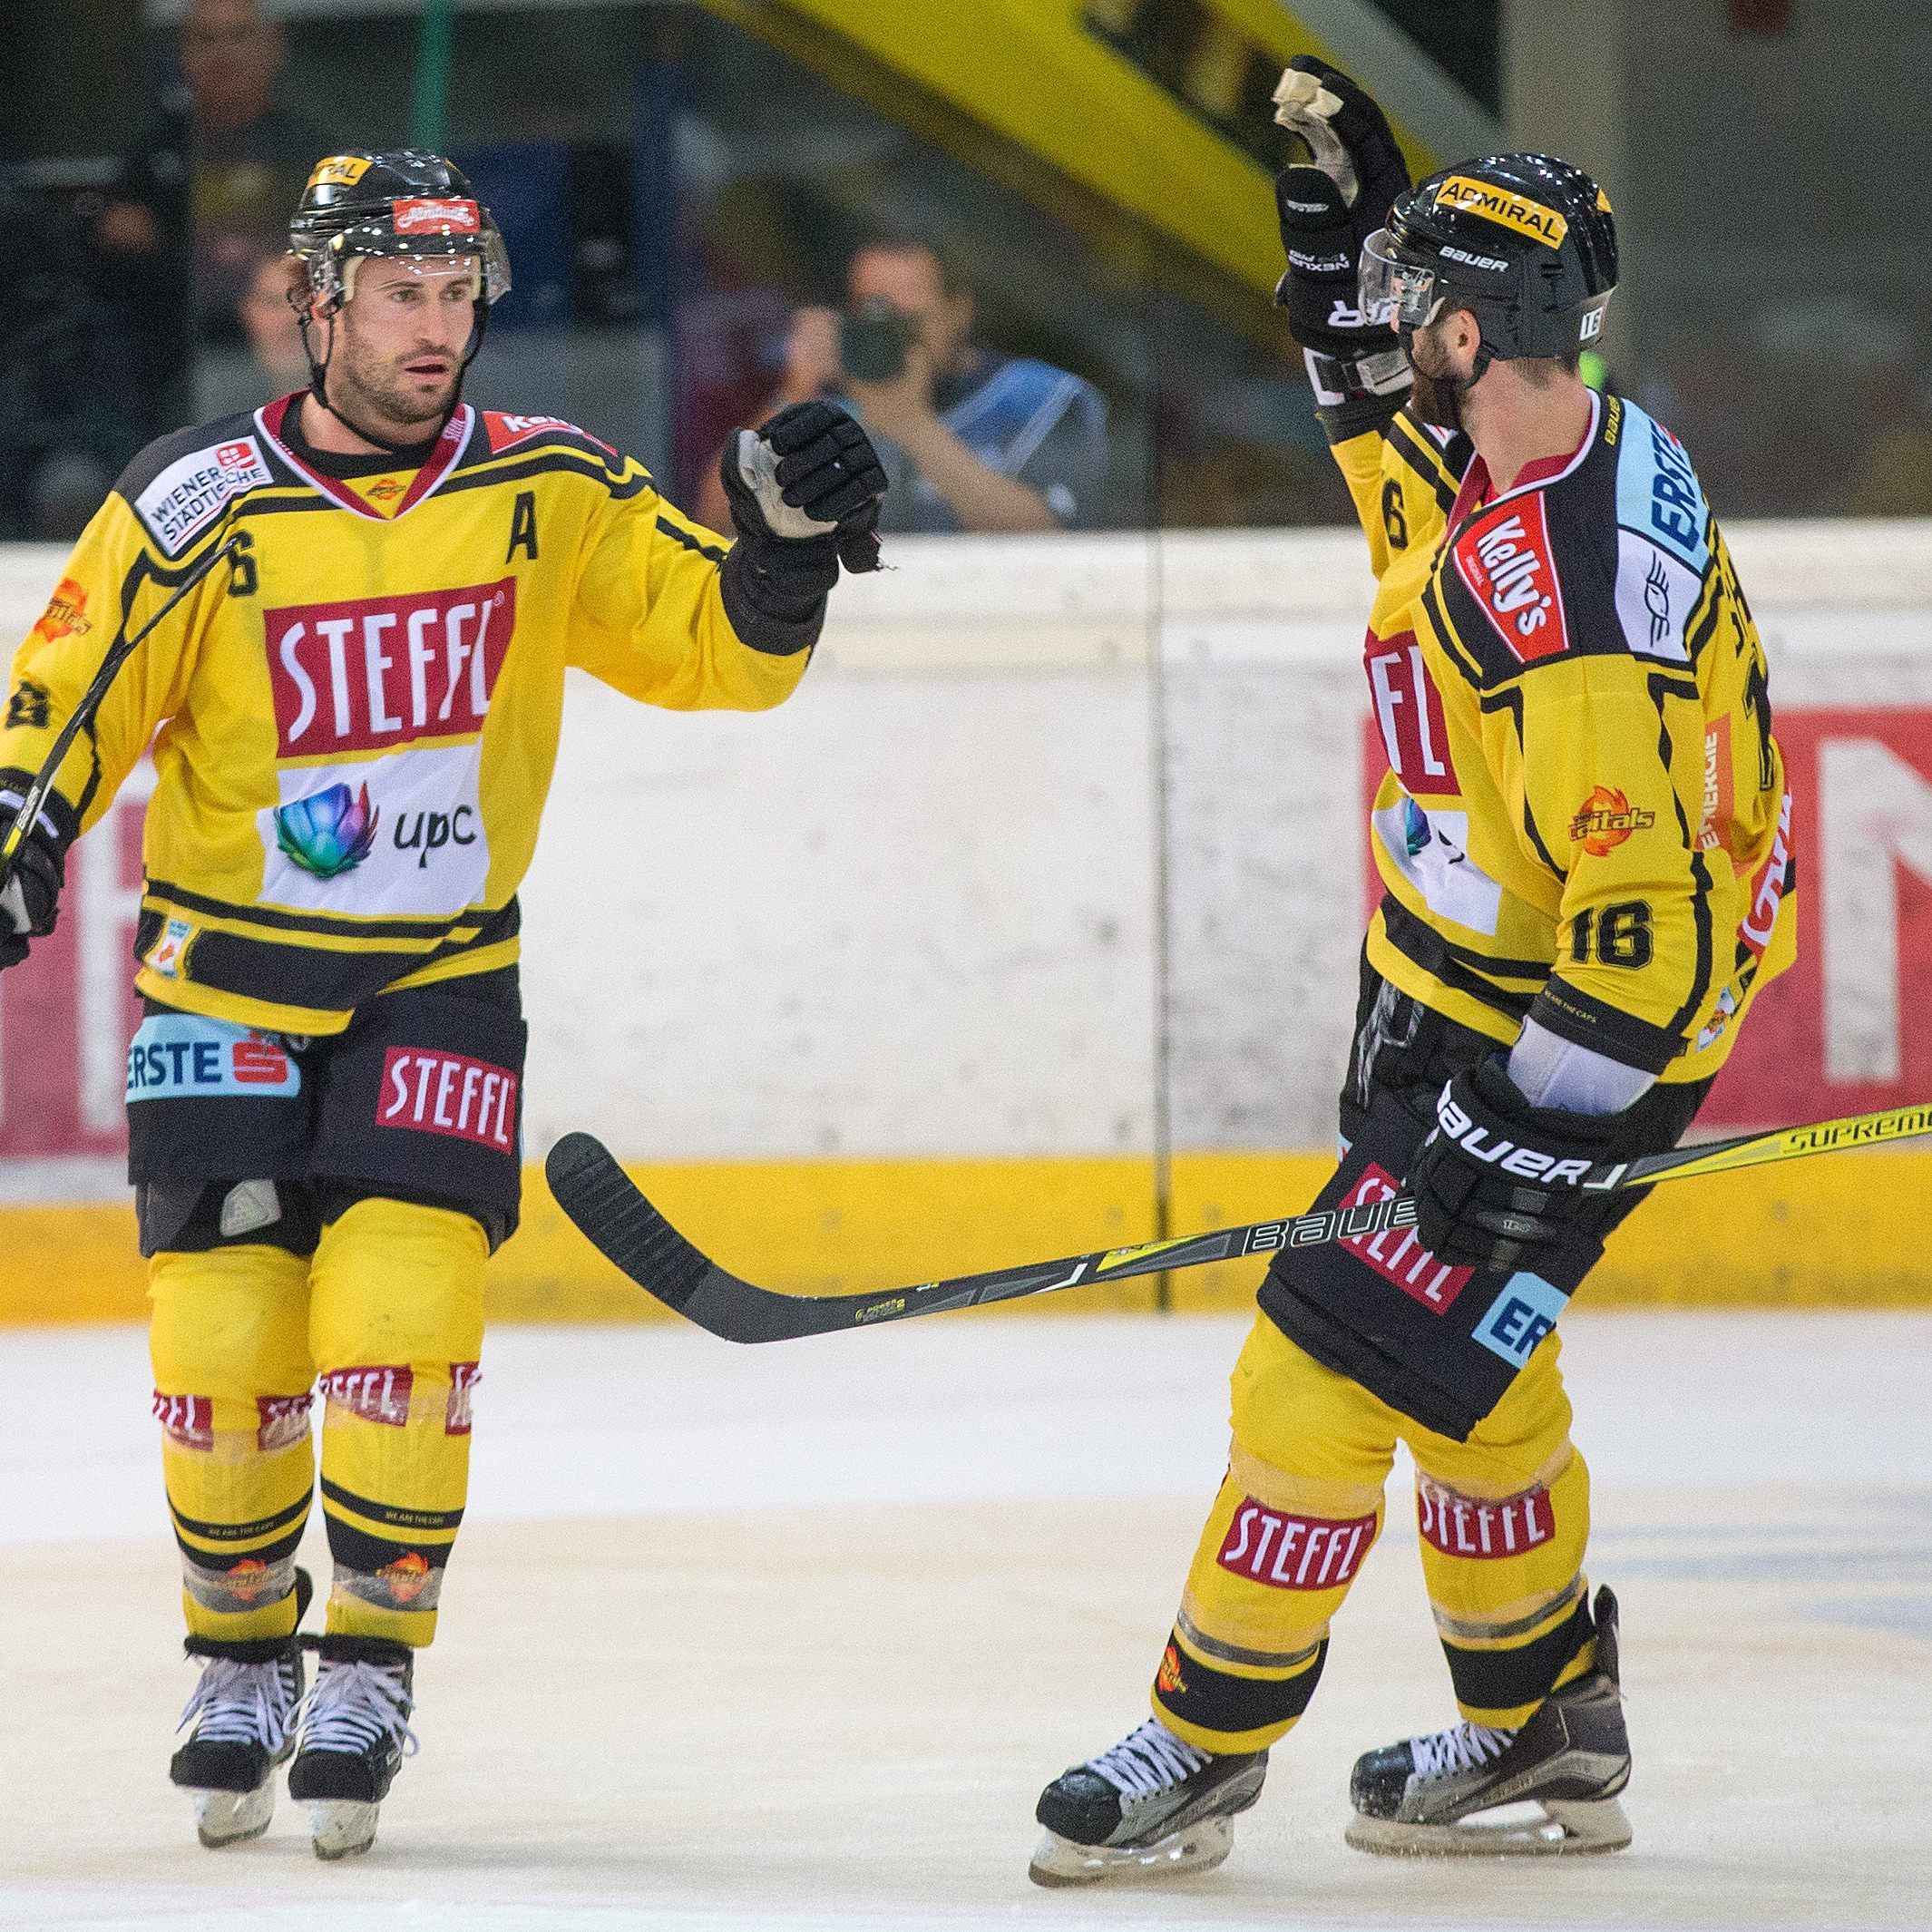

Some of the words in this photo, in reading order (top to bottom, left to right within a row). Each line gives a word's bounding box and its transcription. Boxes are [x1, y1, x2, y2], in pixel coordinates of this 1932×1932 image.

[1441, 182, 1559, 242] ADMIRAL
[1439, 246, 1509, 272] BAUER
[151, 466, 223, 523] WIENER
[505, 491, 539, 564] A
[1477, 514, 1552, 636] Kelly's
[279, 600, 493, 744] STEFFL
[393, 804, 476, 868] upc
[1571, 901, 1654, 969] 16
[385, 1055, 511, 1144] STEFFL
[1243, 1197, 1420, 1255] BAUE
[1225, 1507, 1364, 1586] STEFFL
[1420, 1483, 1546, 1554] STEFFL
